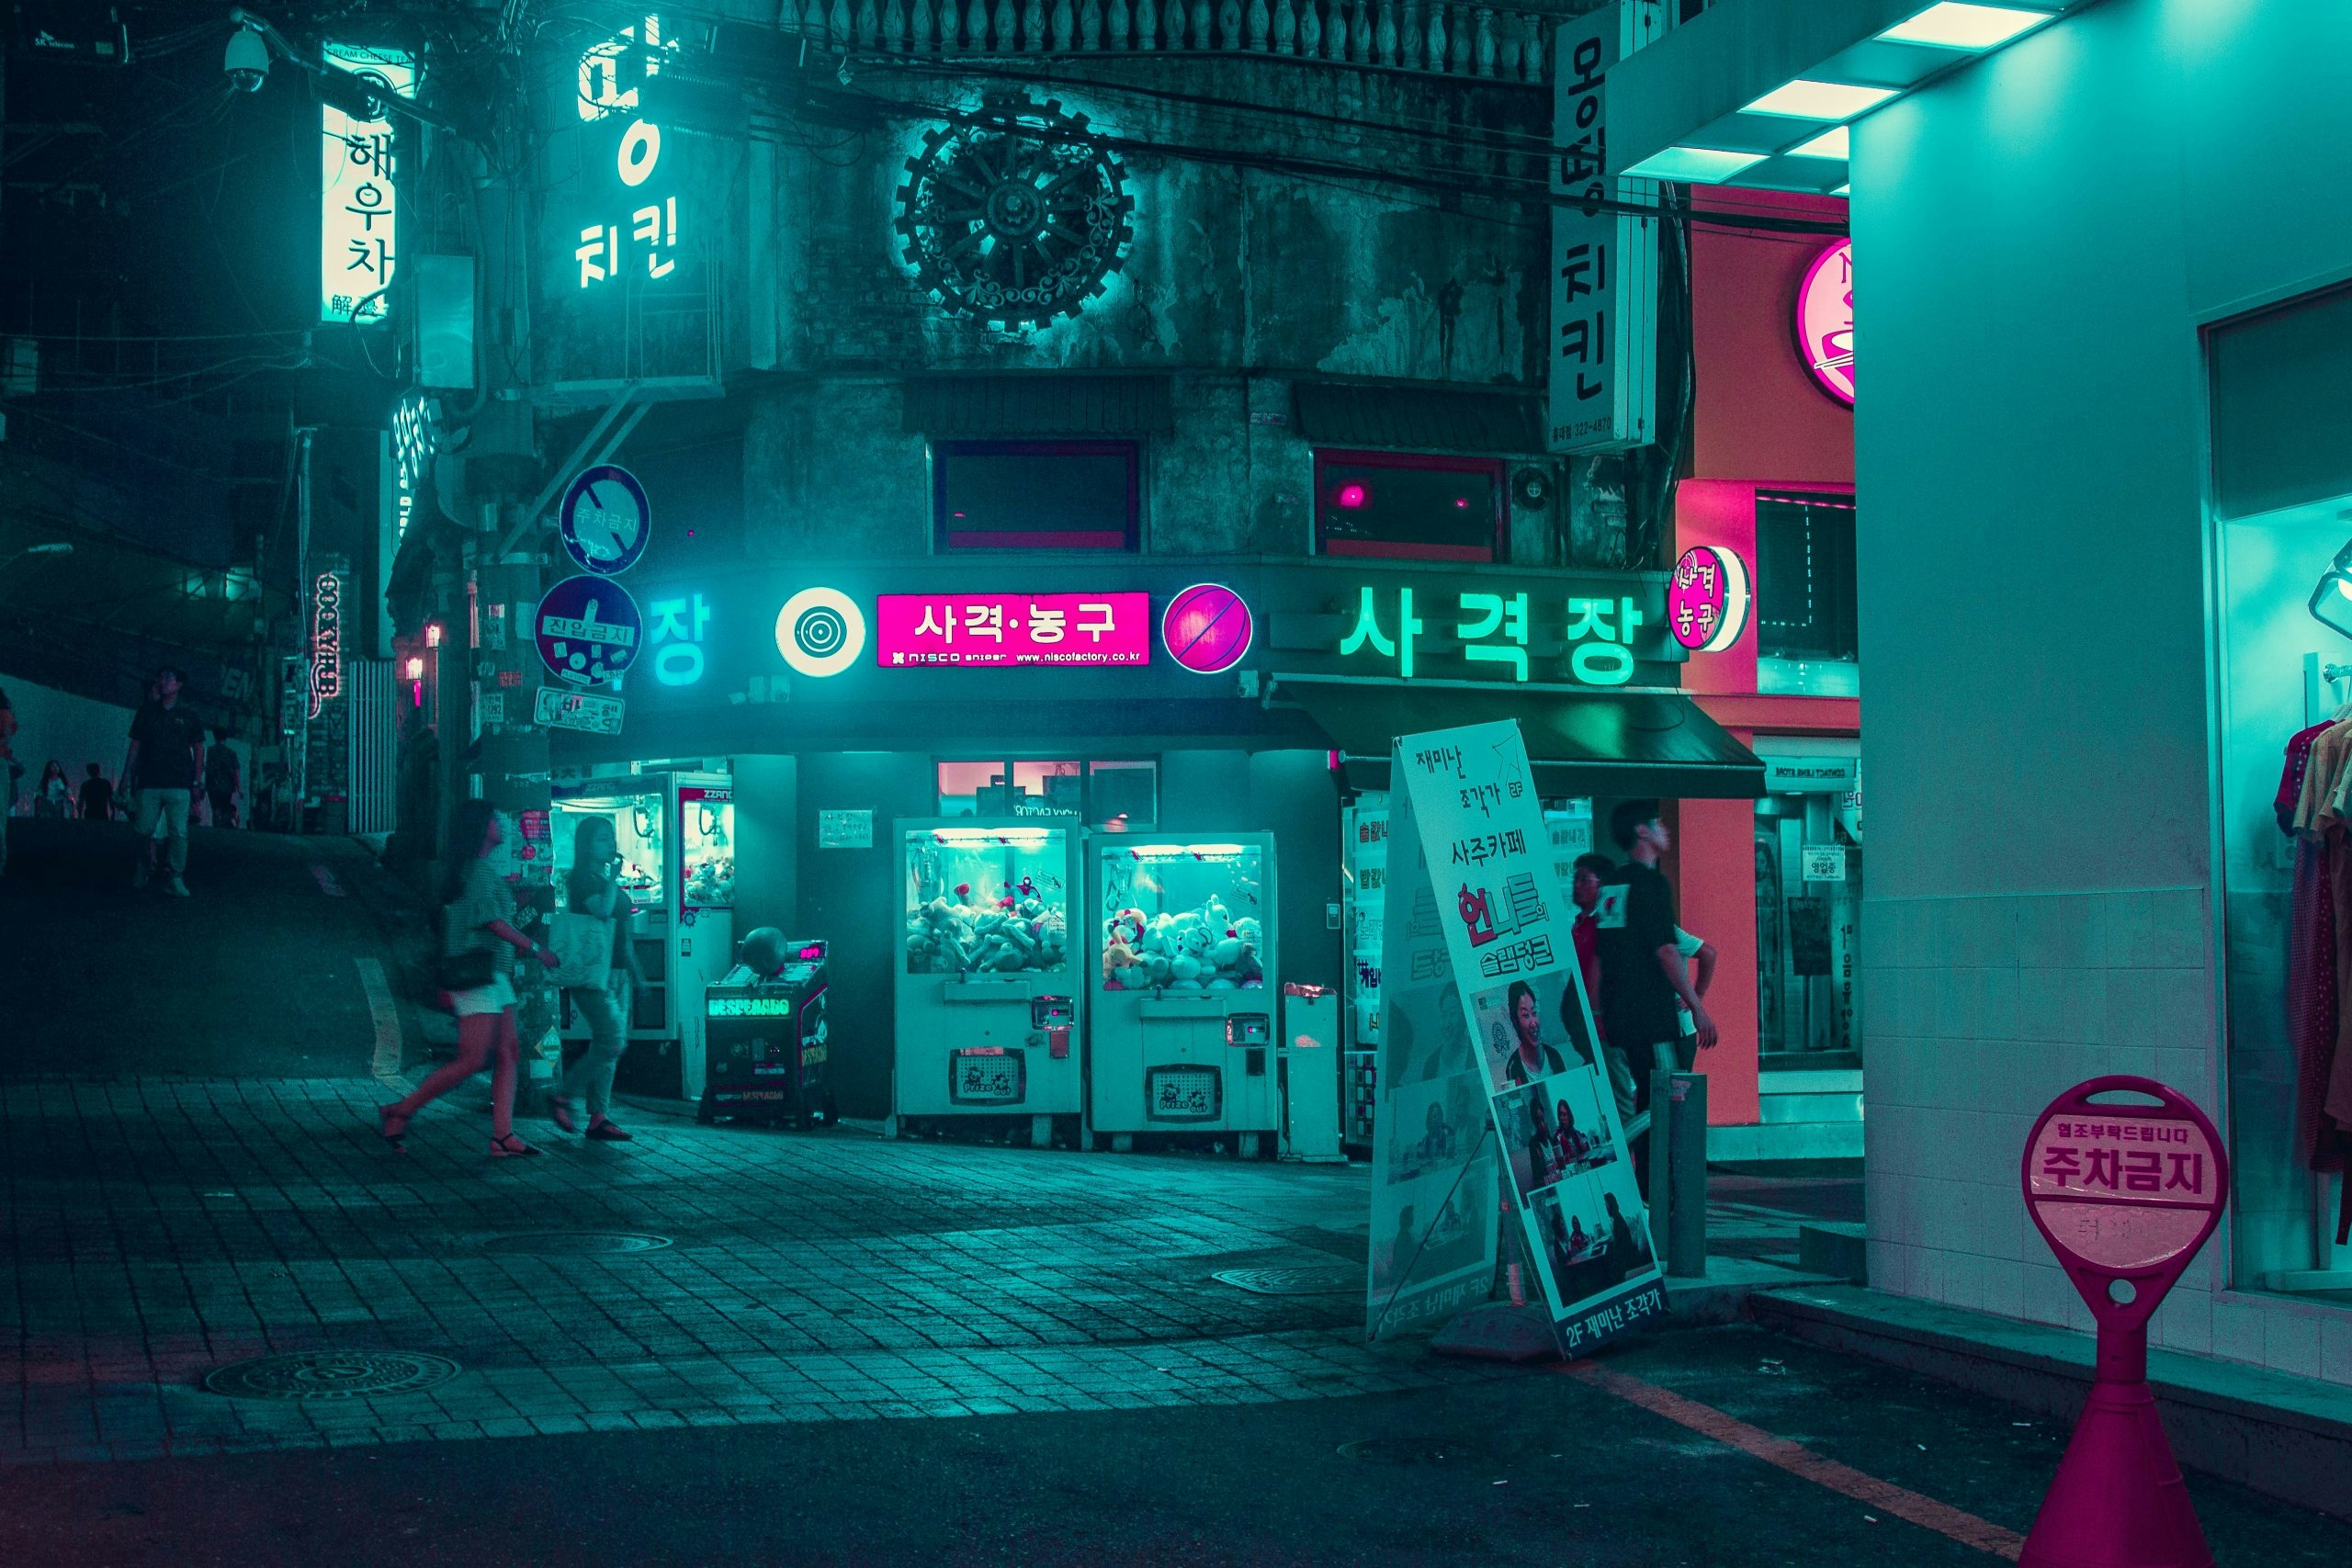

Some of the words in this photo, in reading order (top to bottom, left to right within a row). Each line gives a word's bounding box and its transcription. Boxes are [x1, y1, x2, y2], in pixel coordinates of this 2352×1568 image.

[34, 38, 47, 47] SK
[345, 133, 395, 286] 해우차
[575, 196, 678, 289] 치킨
[1561, 243, 1606, 401] 치킨
[576, 506, 639, 533] 주차금지
[1679, 562, 1716, 599] 사격
[549, 618, 629, 643] 진입금지
[1340, 586, 1644, 685] 사격장
[1677, 599, 1714, 637] 농구
[650, 592, 711, 686] 장
[1015, 651, 1141, 663] www.niscofactory.co.kr
[1416, 744, 1467, 780] 재미난
[1459, 782, 1501, 818] 조각가
[1452, 829, 1527, 867] 사주카페
[1811, 862, 1837, 874] 영업중
[1479, 933, 1555, 978] 슬램덩크
[2056, 1122, 2188, 1145] 협조부탁드립니다
[2042, 1145, 2203, 1195] 주차금지
[1566, 1322, 1583, 1348] 2F
[1584, 1303, 1625, 1339] 재미난
[1623, 1287, 1662, 1321] 조각가
